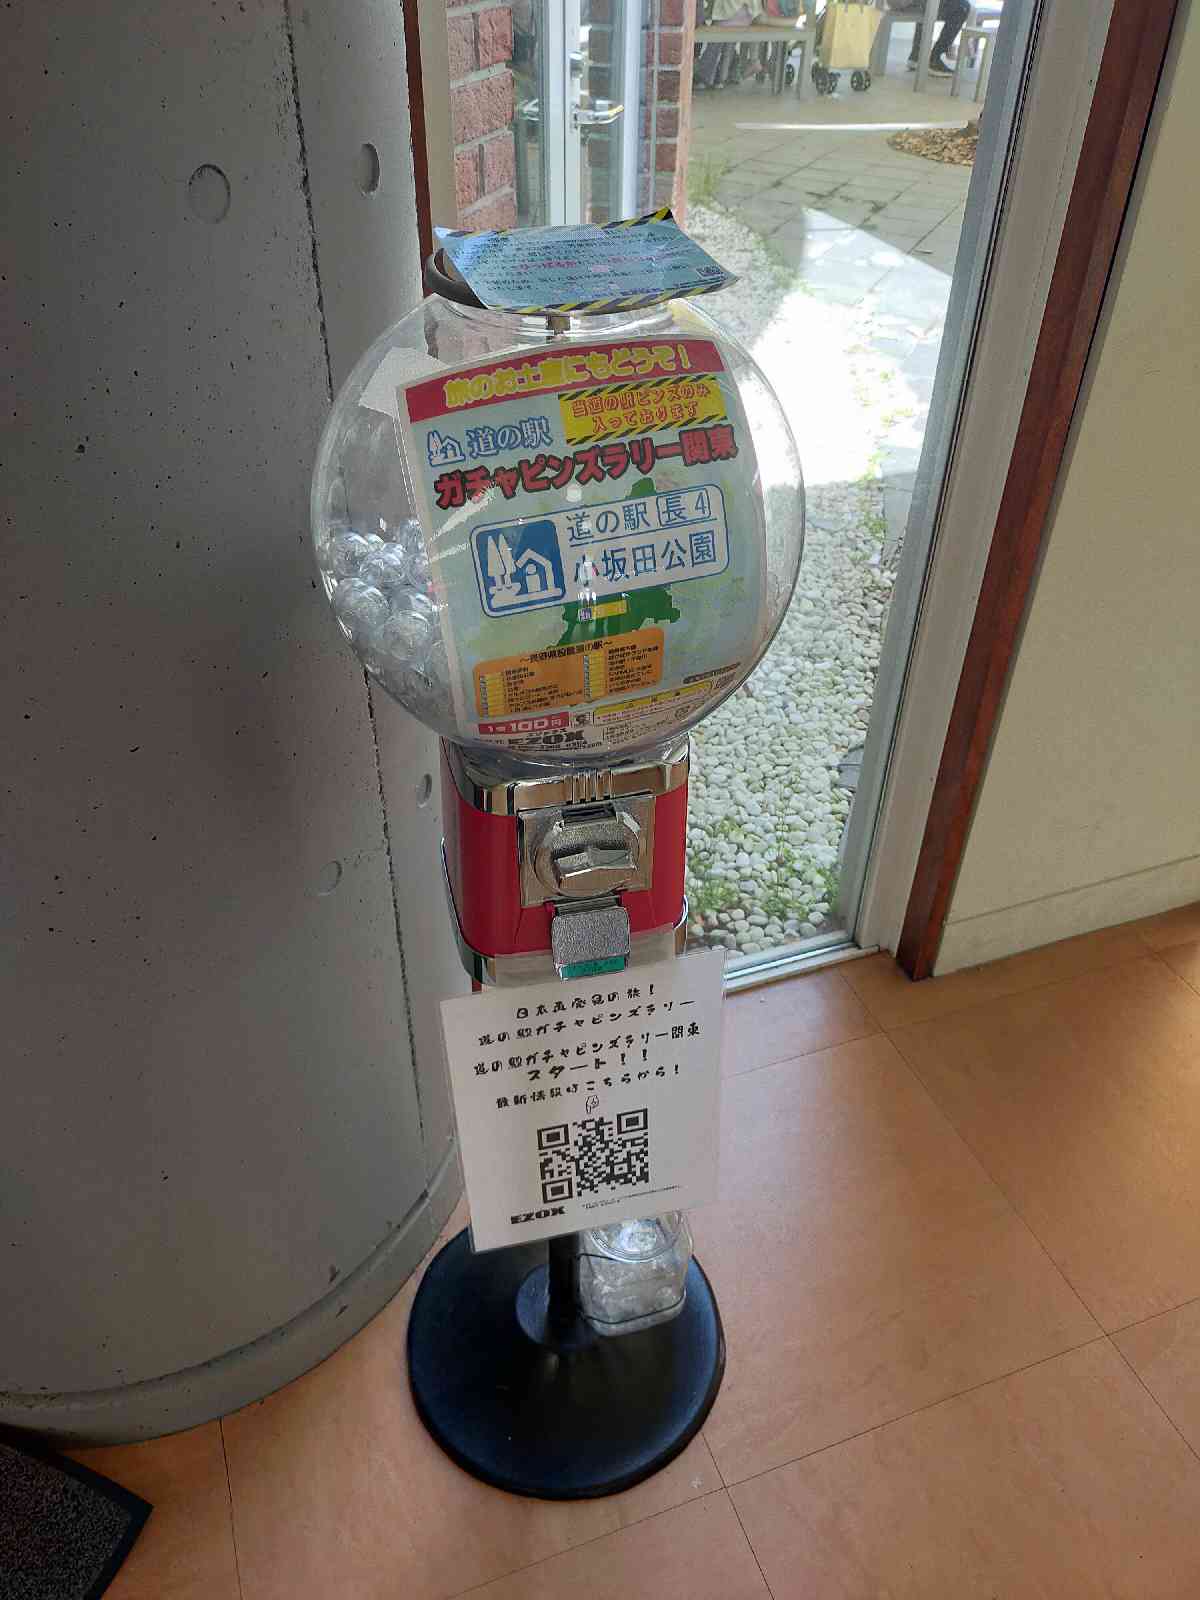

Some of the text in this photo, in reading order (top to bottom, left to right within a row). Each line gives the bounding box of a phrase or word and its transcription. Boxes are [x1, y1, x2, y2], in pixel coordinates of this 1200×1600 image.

[466, 416, 553, 459] 道の駅
[434, 424, 738, 509] ガチャピンズラリー関東
[566, 501, 650, 542] 道の駅
[510, 1206, 566, 1224] EZOX
